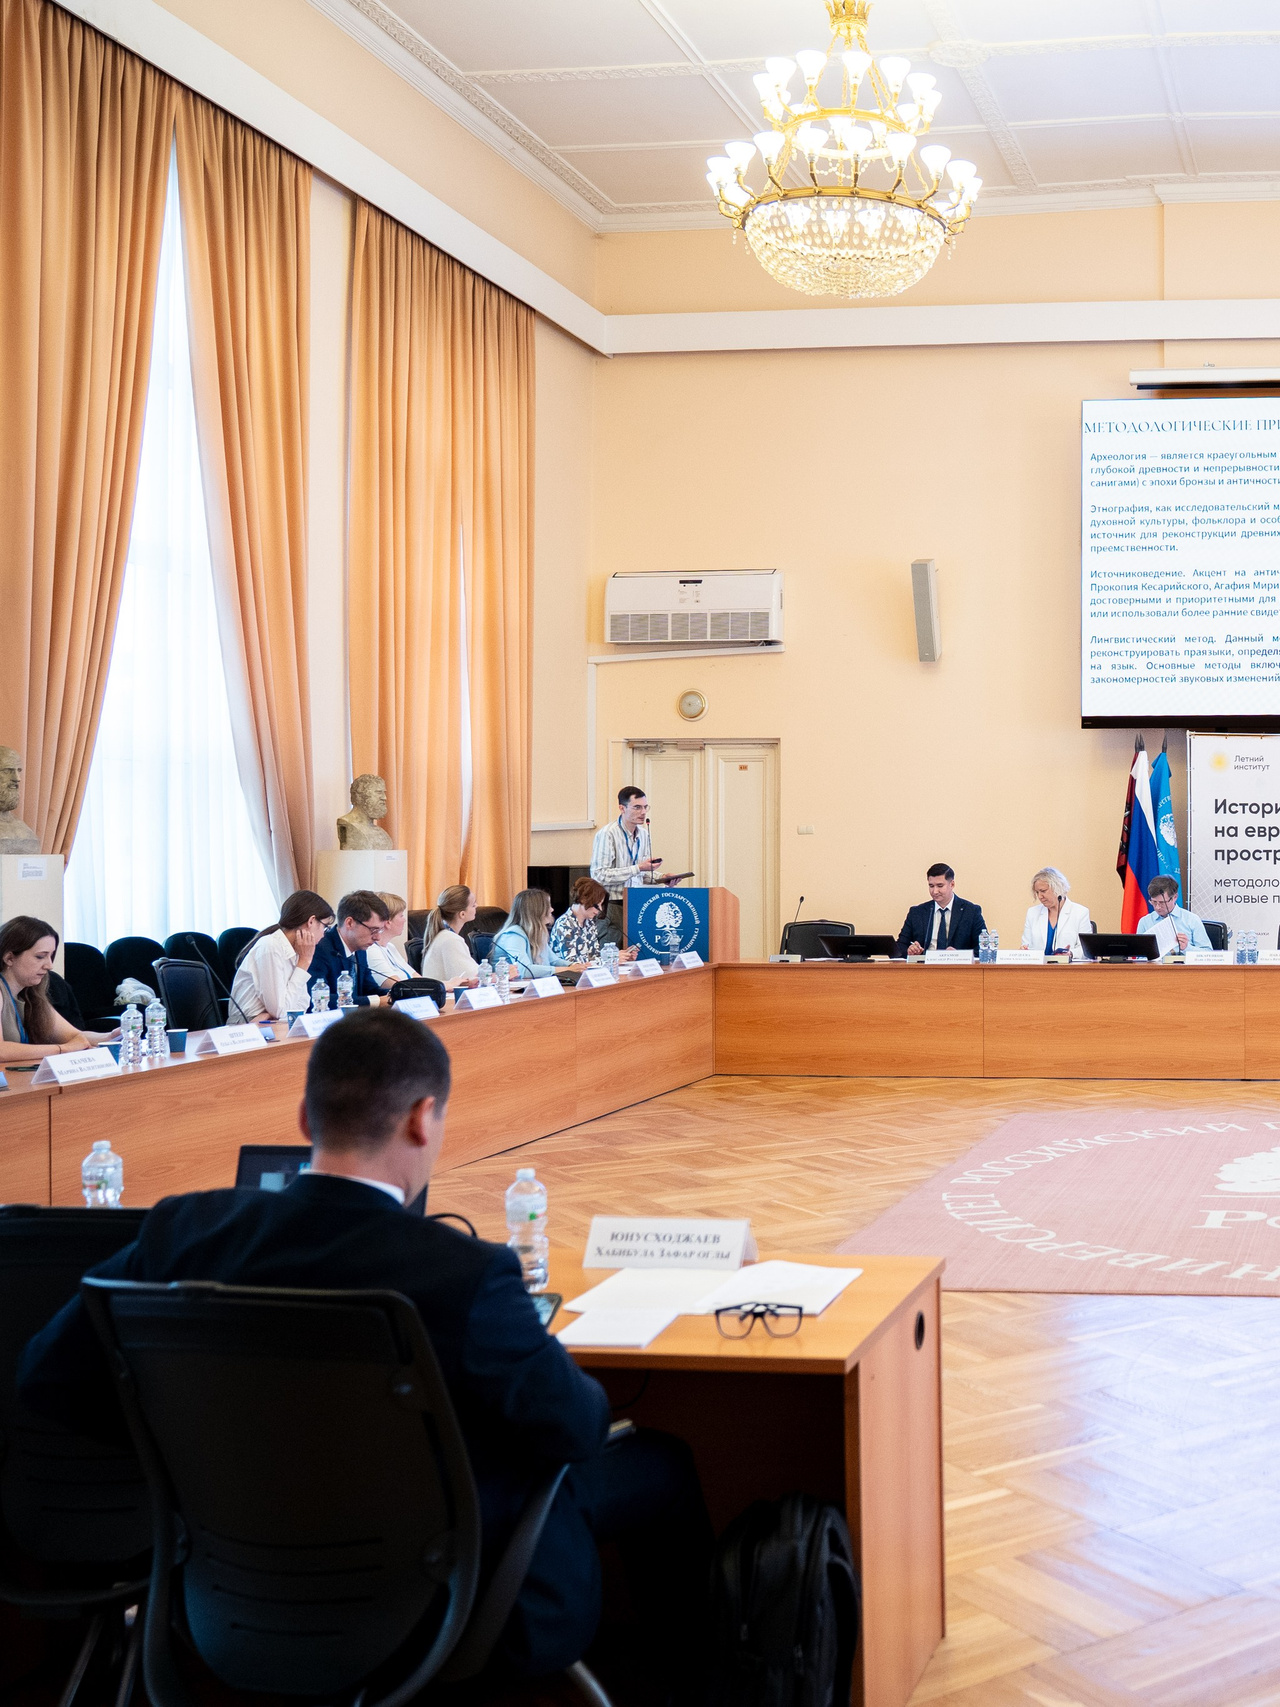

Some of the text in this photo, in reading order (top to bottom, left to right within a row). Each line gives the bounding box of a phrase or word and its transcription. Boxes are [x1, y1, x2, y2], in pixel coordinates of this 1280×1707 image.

[1084, 420, 1252, 433] МЕТОДОЛОГИЧЕСКИЕ
[1090, 453, 1146, 462] Археология
[1160, 452, 1204, 460] является
[1206, 451, 1276, 461] краеугольным
[1090, 464, 1135, 476] глубокой
[1138, 465, 1190, 475] древности
[1202, 464, 1279, 474] непрерывности
[1090, 478, 1139, 488] санигами)
[1149, 479, 1177, 487] эпохи
[1179, 476, 1215, 487] бронзы
[1090, 504, 1152, 515] Этнография,
[1174, 502, 1270, 512] исследовательский
[1090, 516, 1135, 528] духовной
[1139, 518, 1188, 527] культуры,
[1191, 516, 1246, 526] фольклора
[1162, 531, 1236, 540] реконструкции
[1240, 530, 1280, 539] древних
[1090, 544, 1178, 554] преемственности.
[1090, 570, 1185, 578] Источниковедение.
[1192, 568, 1226, 578] Акцент
[1090, 582, 1138, 593] Прокопия
[1141, 581, 1211, 592] Кесарийского,
[1213, 581, 1250, 591] Агафия
[1089, 597, 1161, 606] достоверными
[1175, 596, 1254, 605] приоритетными
[1090, 635, 1176, 644] Лингвистический
[1184, 635, 1216, 644] метод.
[1224, 633, 1263, 644] Данный
[1090, 649, 1180, 659] реконструировать
[1183, 649, 1234, 658] праязыки,
[1146, 661, 1195, 670] Основные
[1204, 662, 1241, 670] методы
[1090, 674, 1176, 684] закономерностей
[1178, 675, 1224, 684] звуковых
[1234, 755, 1264, 763] Летний
[1234, 764, 1270, 772] институт
[1214, 826, 1239, 838] на
[1214, 895, 1222, 904] и
[1226, 895, 1268, 904] новые
[950, 1121, 1250, 1185] РОССИЙСКИЙ
[610, 1232, 721, 1244] ЮНУСХОДЖАЕВ
